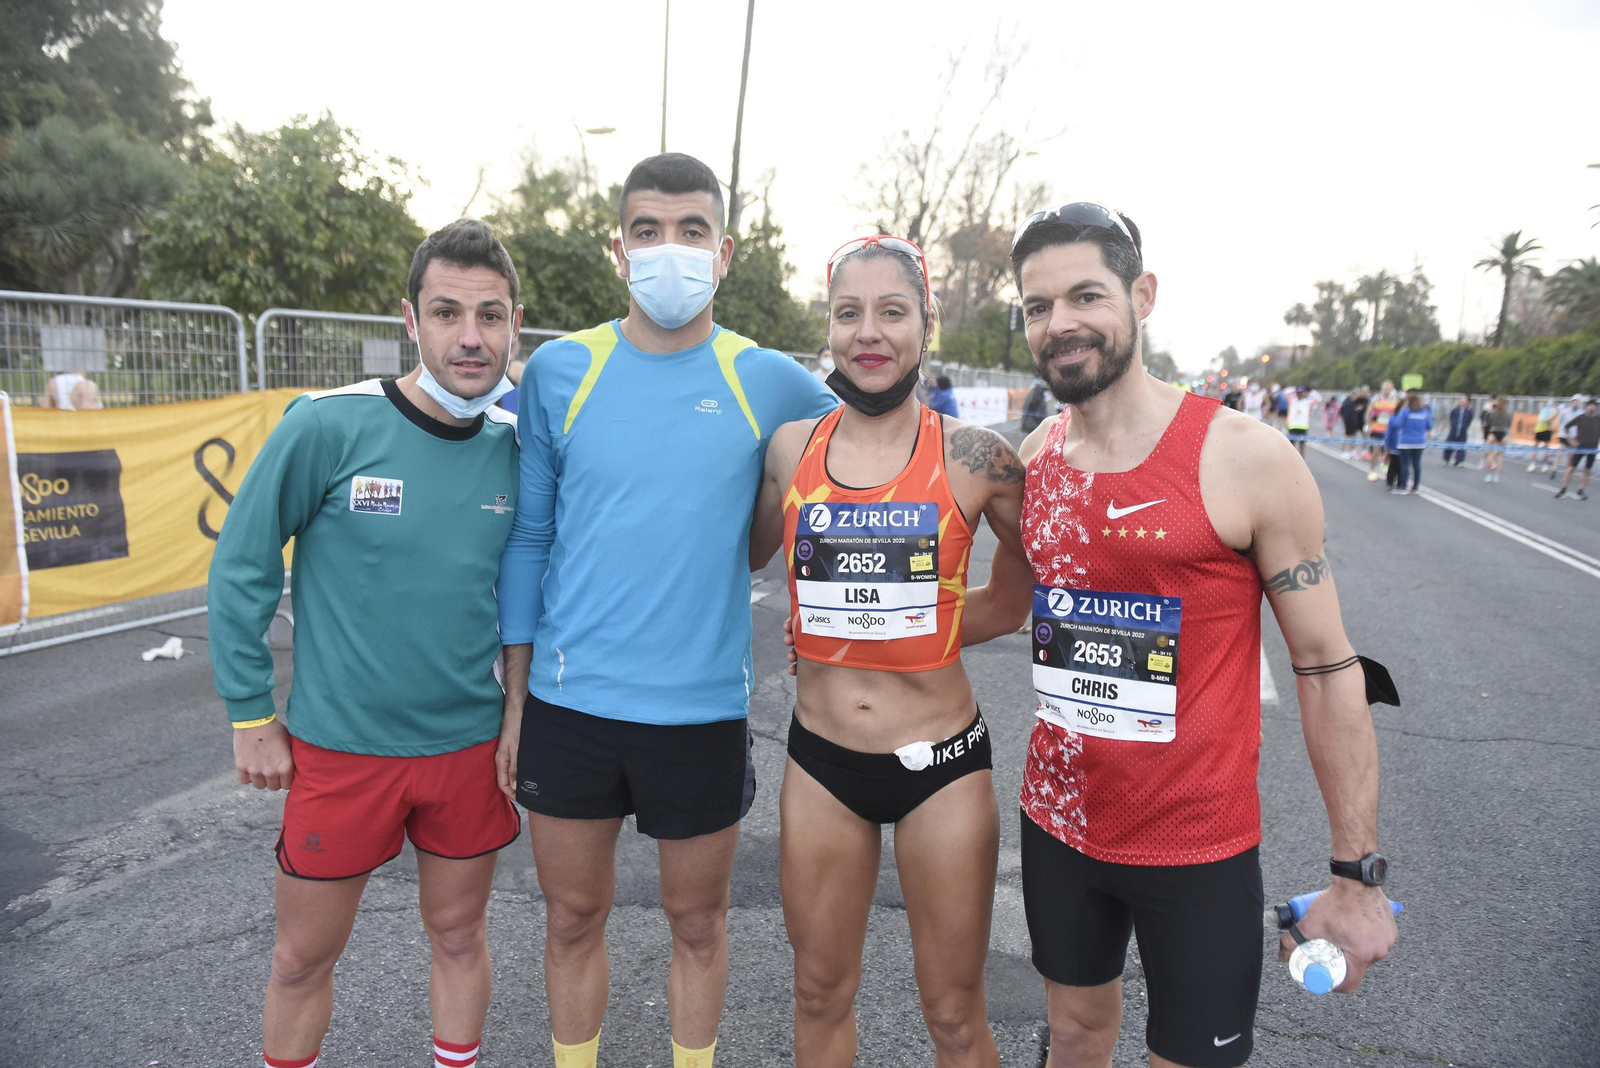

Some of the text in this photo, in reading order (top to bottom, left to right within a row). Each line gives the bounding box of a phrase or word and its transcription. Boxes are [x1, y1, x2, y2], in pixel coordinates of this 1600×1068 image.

[836, 510, 920, 527] ZURICH
[837, 552, 886, 574] 2652
[844, 588, 880, 604] LISA
[1078, 596, 1162, 622] ZURICH
[1060, 622, 1078, 630] ZURICH
[1078, 624, 1104, 634] MARATÓN
[1111, 629, 1131, 637] SEVILLA
[1074, 640, 1122, 668] 2653
[1072, 677, 1118, 700] CHRIS
[936, 717, 986, 765] IKE PRO
